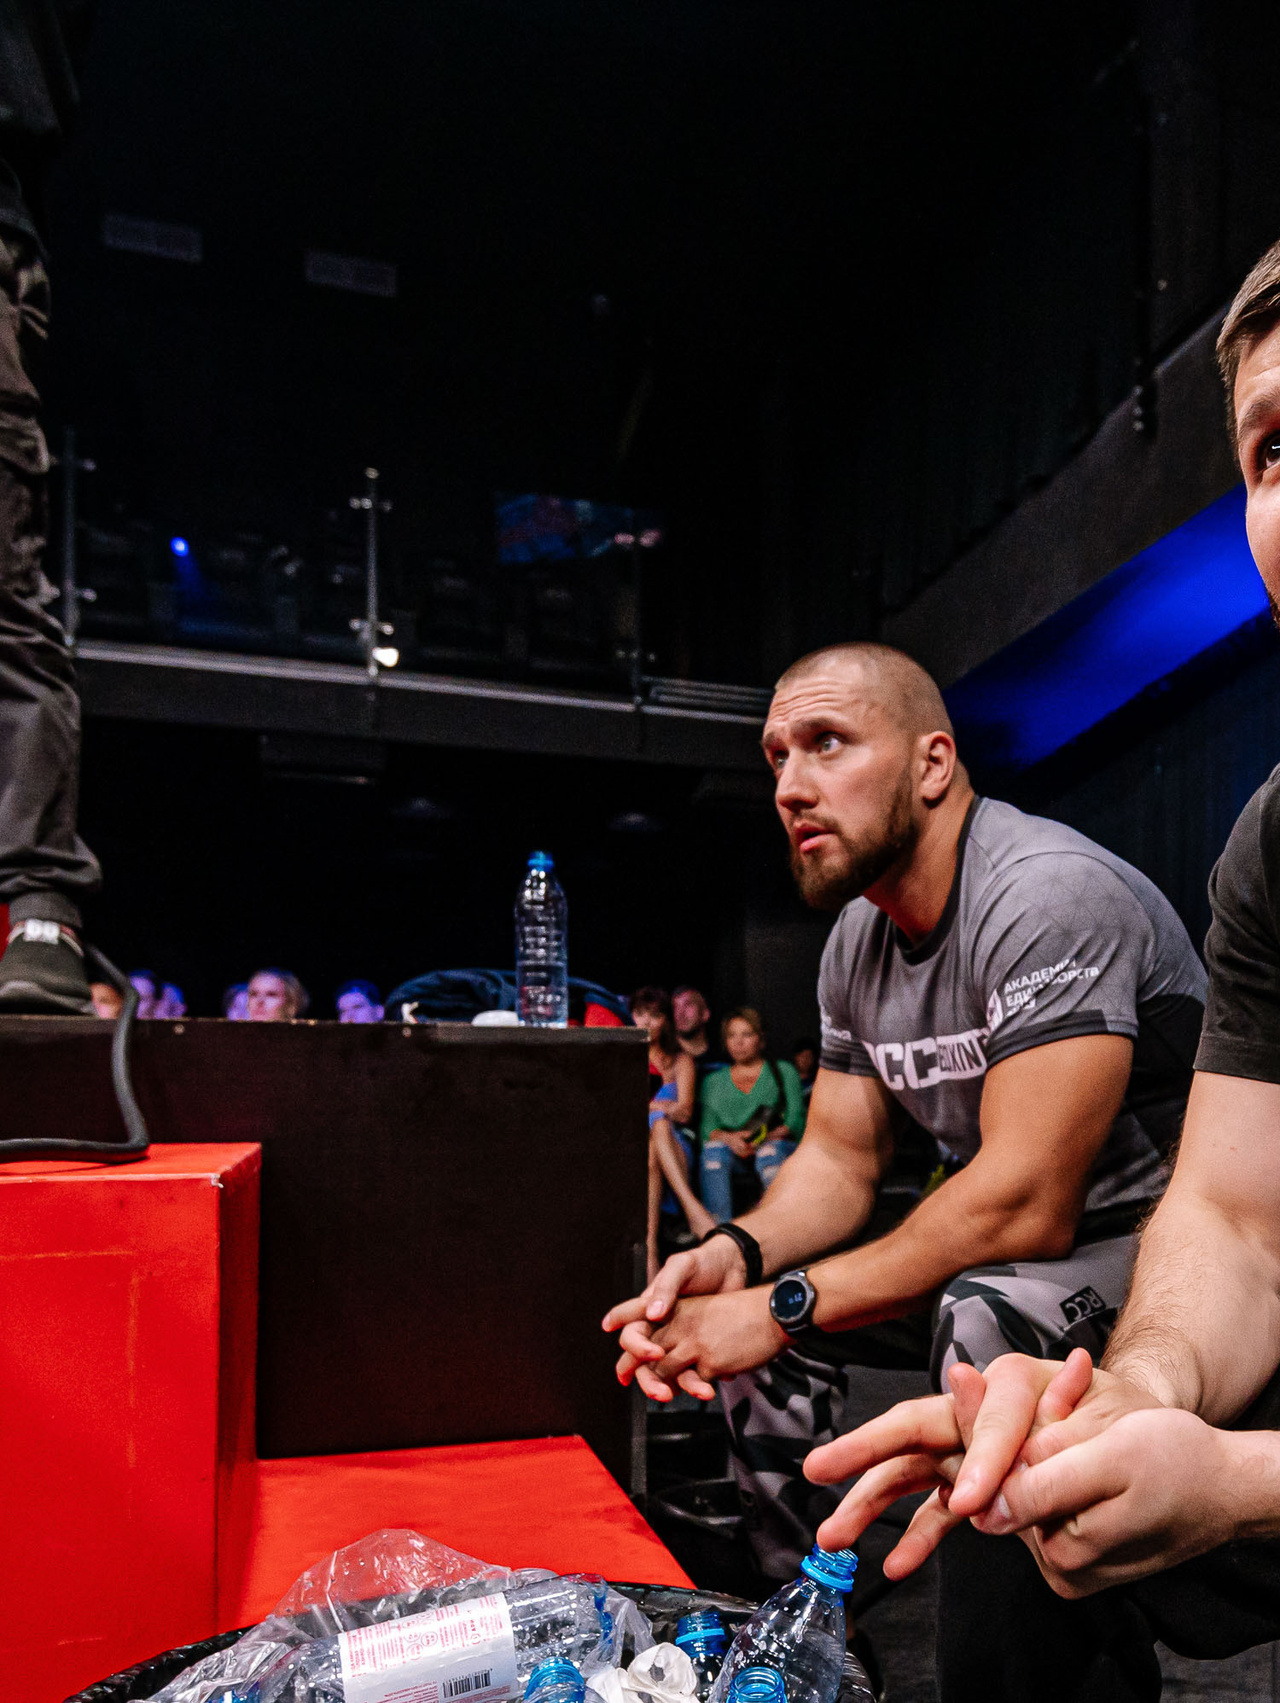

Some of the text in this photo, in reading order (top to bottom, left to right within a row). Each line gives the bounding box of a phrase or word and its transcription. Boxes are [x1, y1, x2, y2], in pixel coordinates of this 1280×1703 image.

[1006, 967, 1099, 1007] ЕДИОРСТВ
[861, 1037, 988, 1090] CC BOXIN
